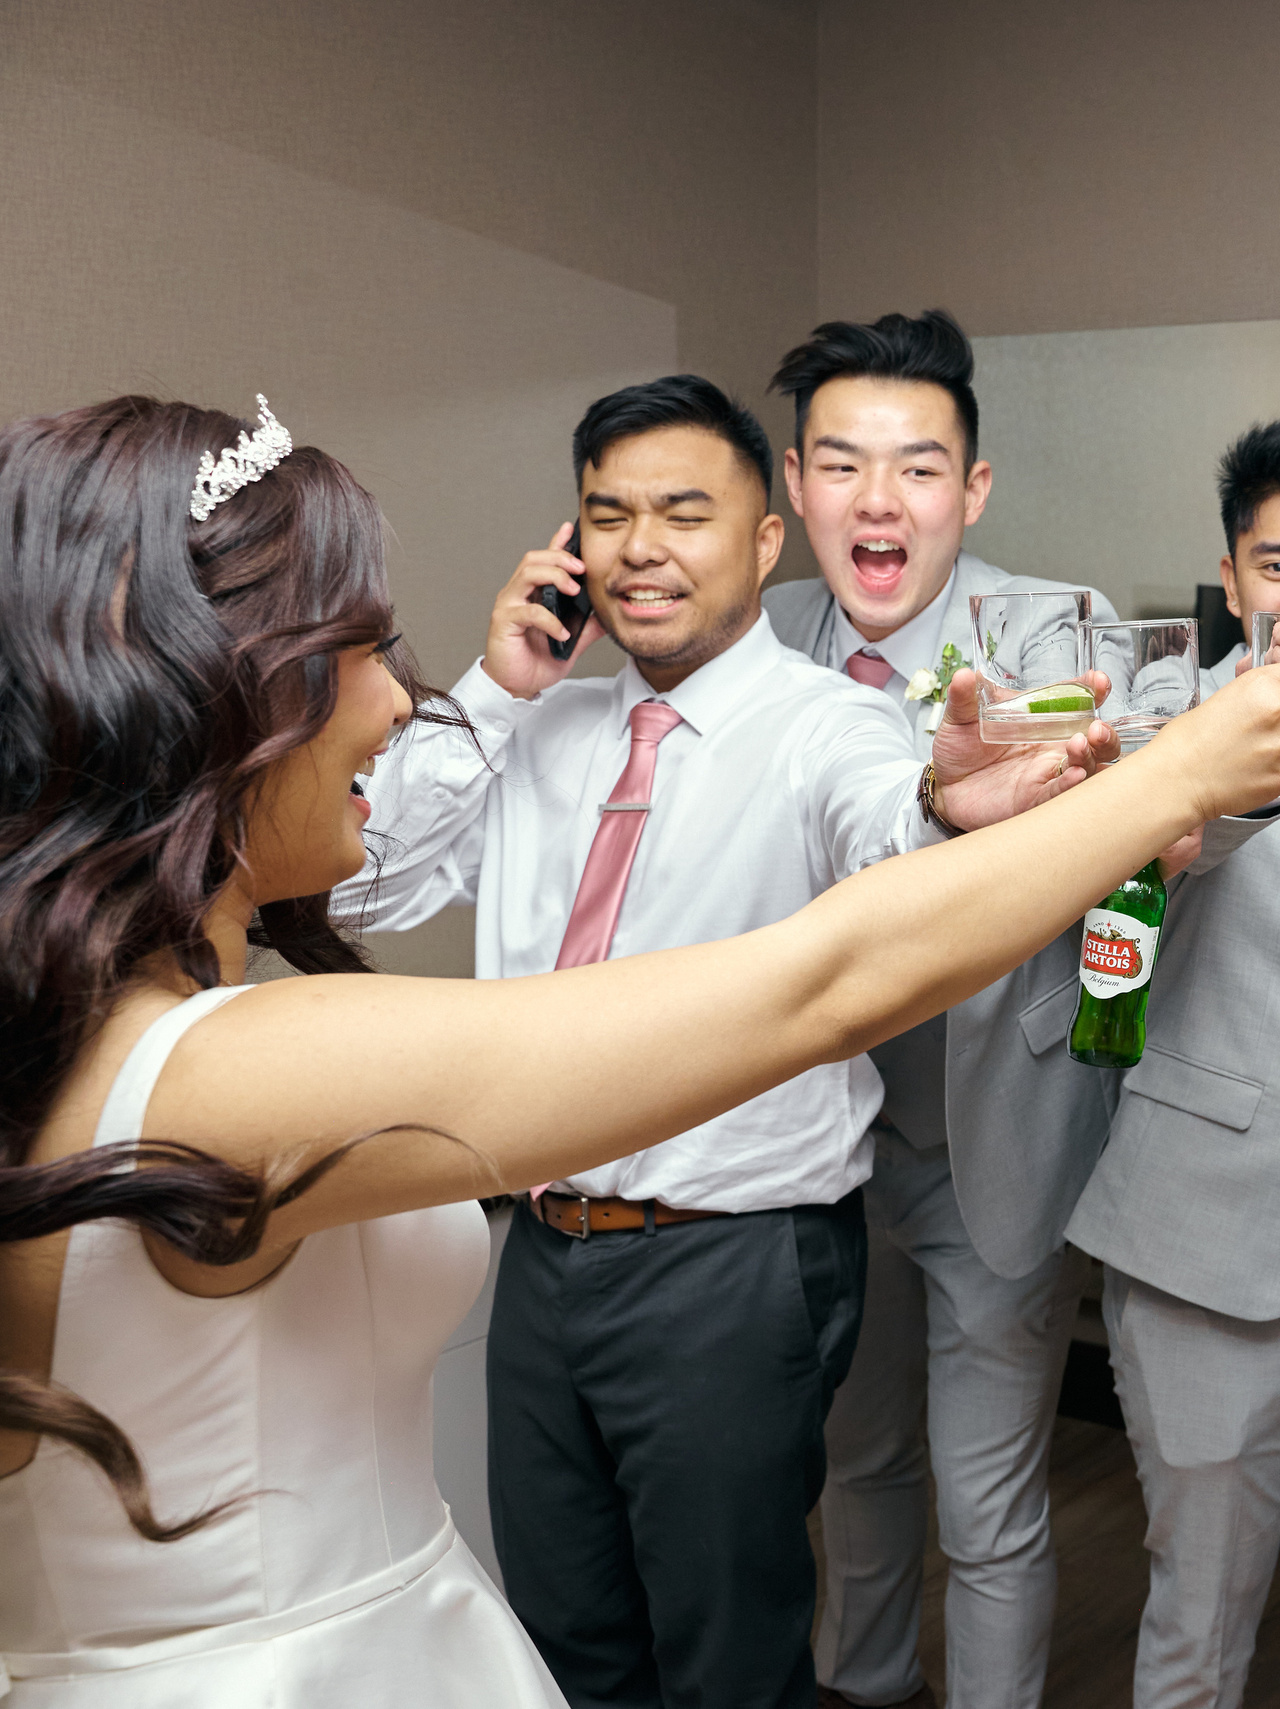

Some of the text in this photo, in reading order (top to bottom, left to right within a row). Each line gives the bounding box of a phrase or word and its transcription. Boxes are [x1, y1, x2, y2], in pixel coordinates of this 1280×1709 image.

[1086, 938, 1131, 958] STELLA
[1084, 950, 1131, 969] ARTOIS
[1087, 972, 1121, 988] Belgium
